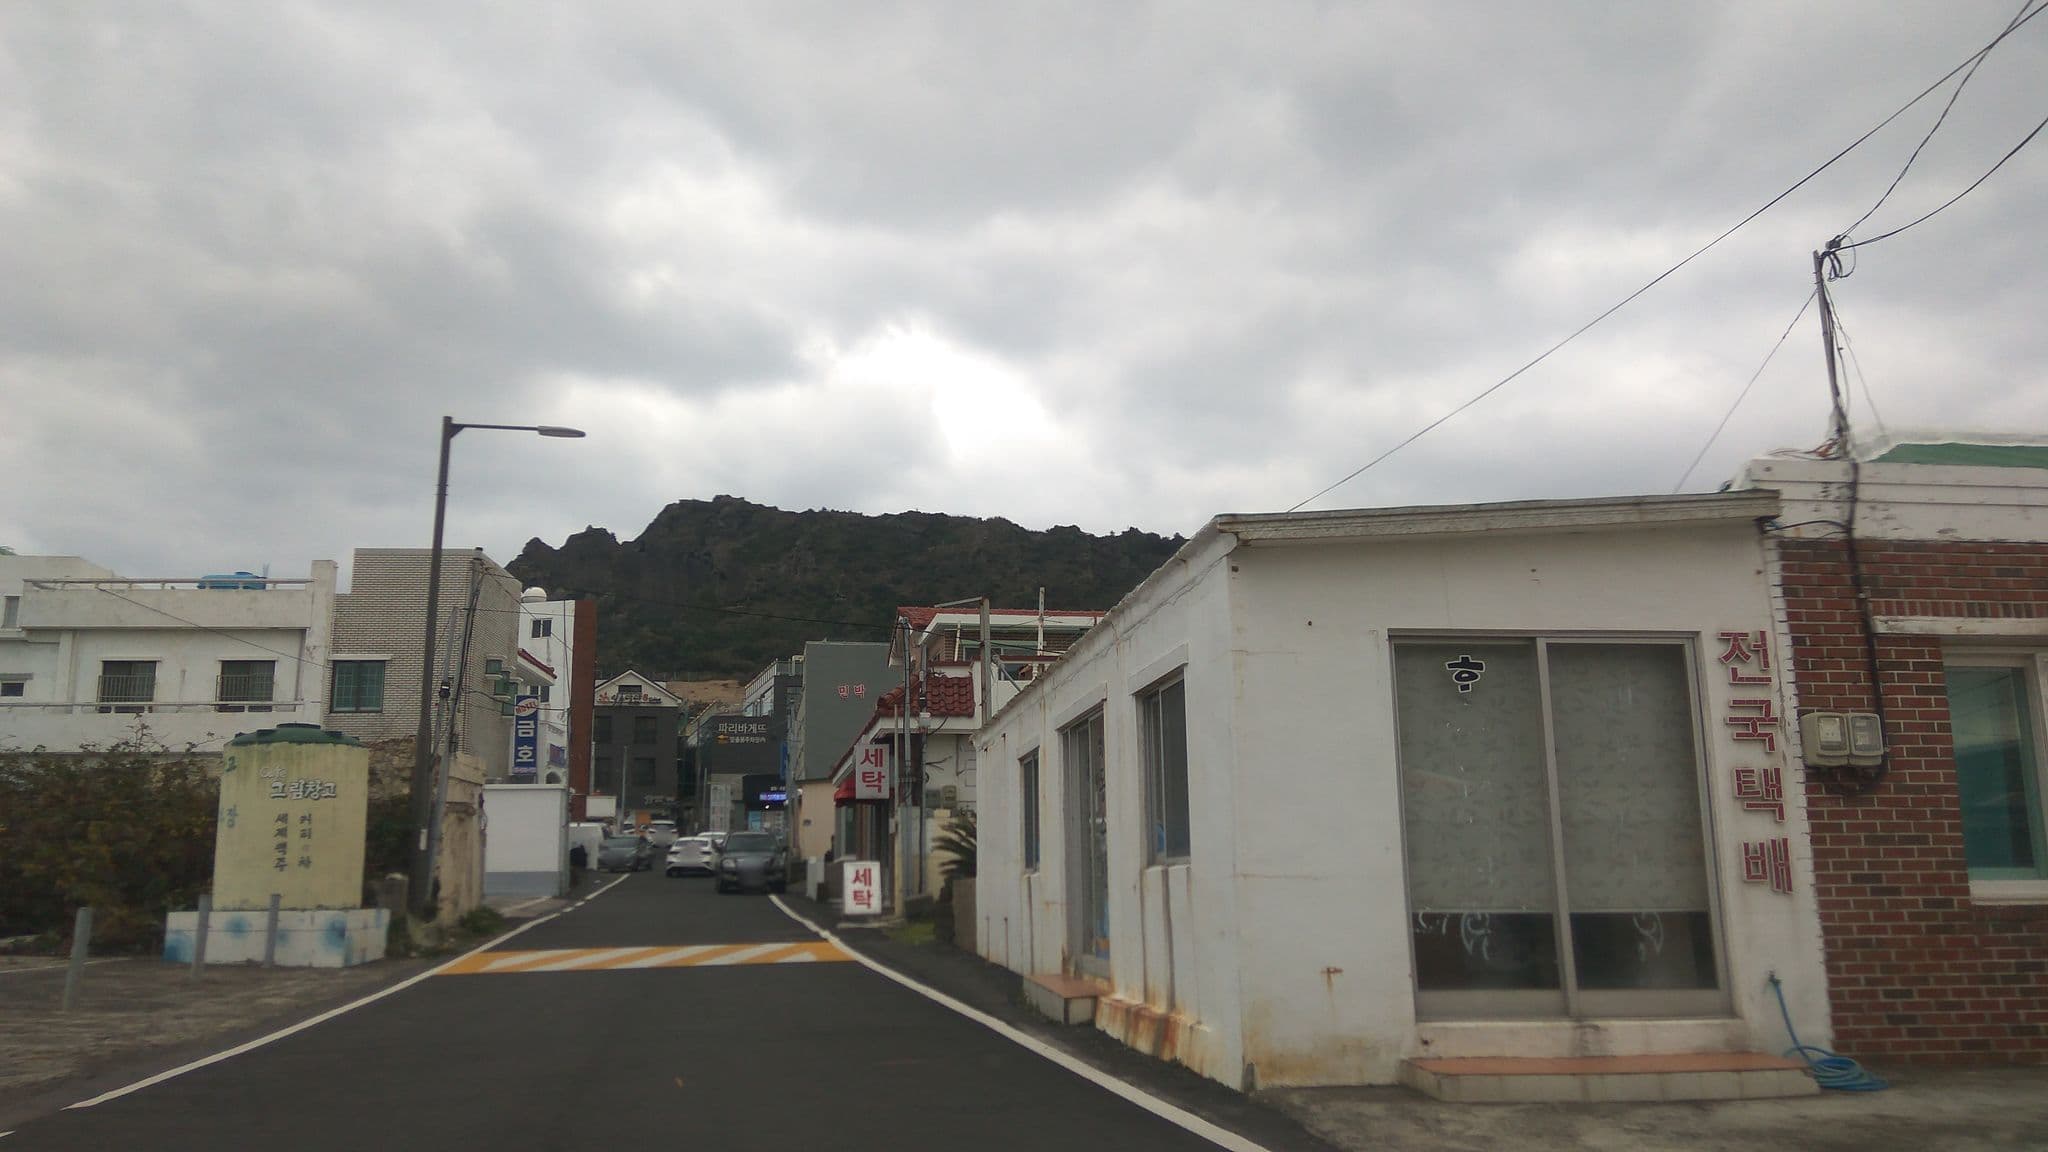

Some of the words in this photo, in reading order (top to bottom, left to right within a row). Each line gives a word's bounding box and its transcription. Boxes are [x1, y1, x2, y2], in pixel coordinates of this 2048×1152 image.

[837, 683, 866, 699] 민박
[516, 720, 535, 763] 금호
[718, 723, 767, 734] 파리바게뜨
[860, 747, 886, 793] 세탁
[1718, 629, 1795, 895] 전국택배
[271, 780, 337, 800] 그림창고
[851, 867, 874, 910] 세탁
